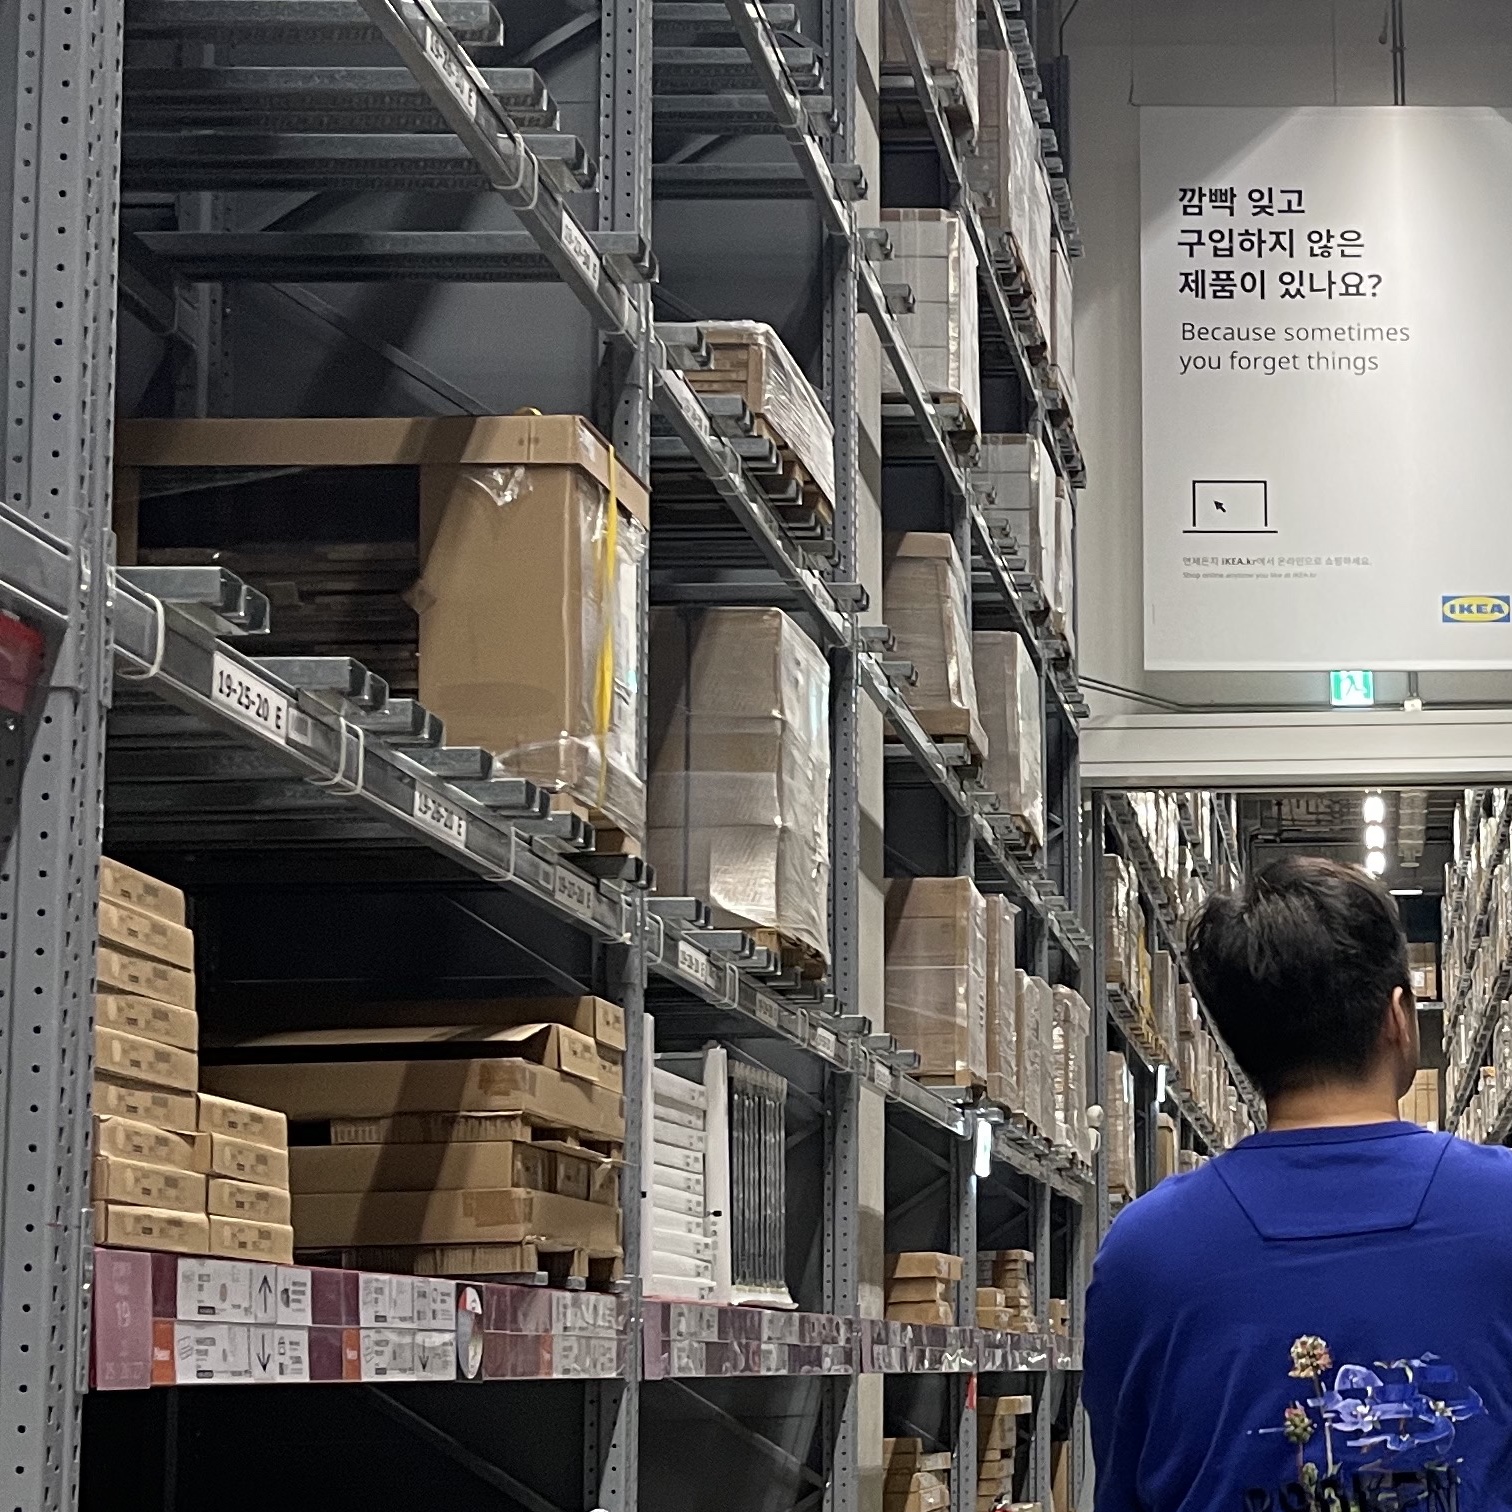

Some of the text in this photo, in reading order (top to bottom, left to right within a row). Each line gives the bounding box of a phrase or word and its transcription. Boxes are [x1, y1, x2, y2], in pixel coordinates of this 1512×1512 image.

[1178, 187, 1305, 217] 깜빡 잊고
[1178, 228, 1364, 258] 구입하지 않은
[1178, 269, 1383, 300] 제품이 있나요?
[1182, 322, 1410, 341] Because sometimes
[1179, 350, 1379, 376] you forget things
[1449, 604, 1505, 614] IKEA
[219, 670, 282, 730] 19-25-20 E
